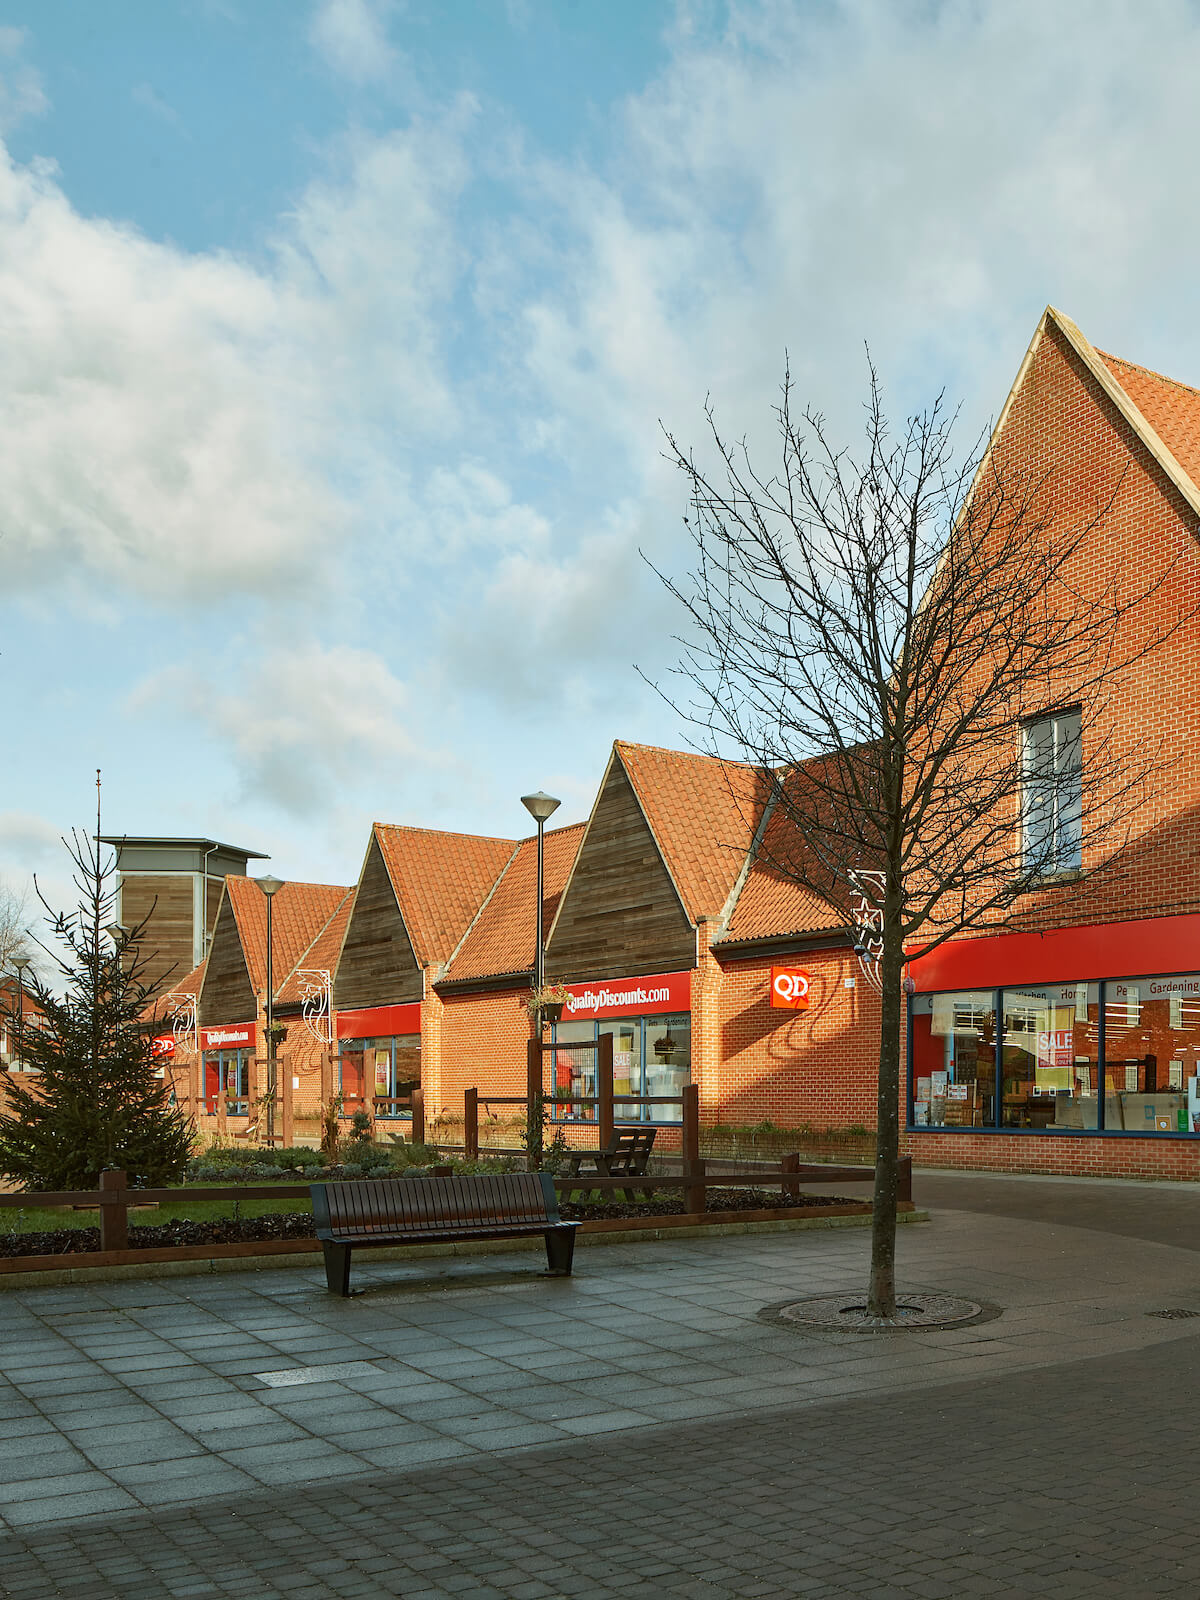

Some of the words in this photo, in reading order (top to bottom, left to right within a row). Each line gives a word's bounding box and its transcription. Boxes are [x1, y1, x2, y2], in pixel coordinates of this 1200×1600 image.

[774, 974, 809, 1002] QD
[1149, 979, 1200, 995] Gardening
[566, 986, 670, 1014] QualityDiscounts.com
[1038, 1032, 1073, 1050] SALE
